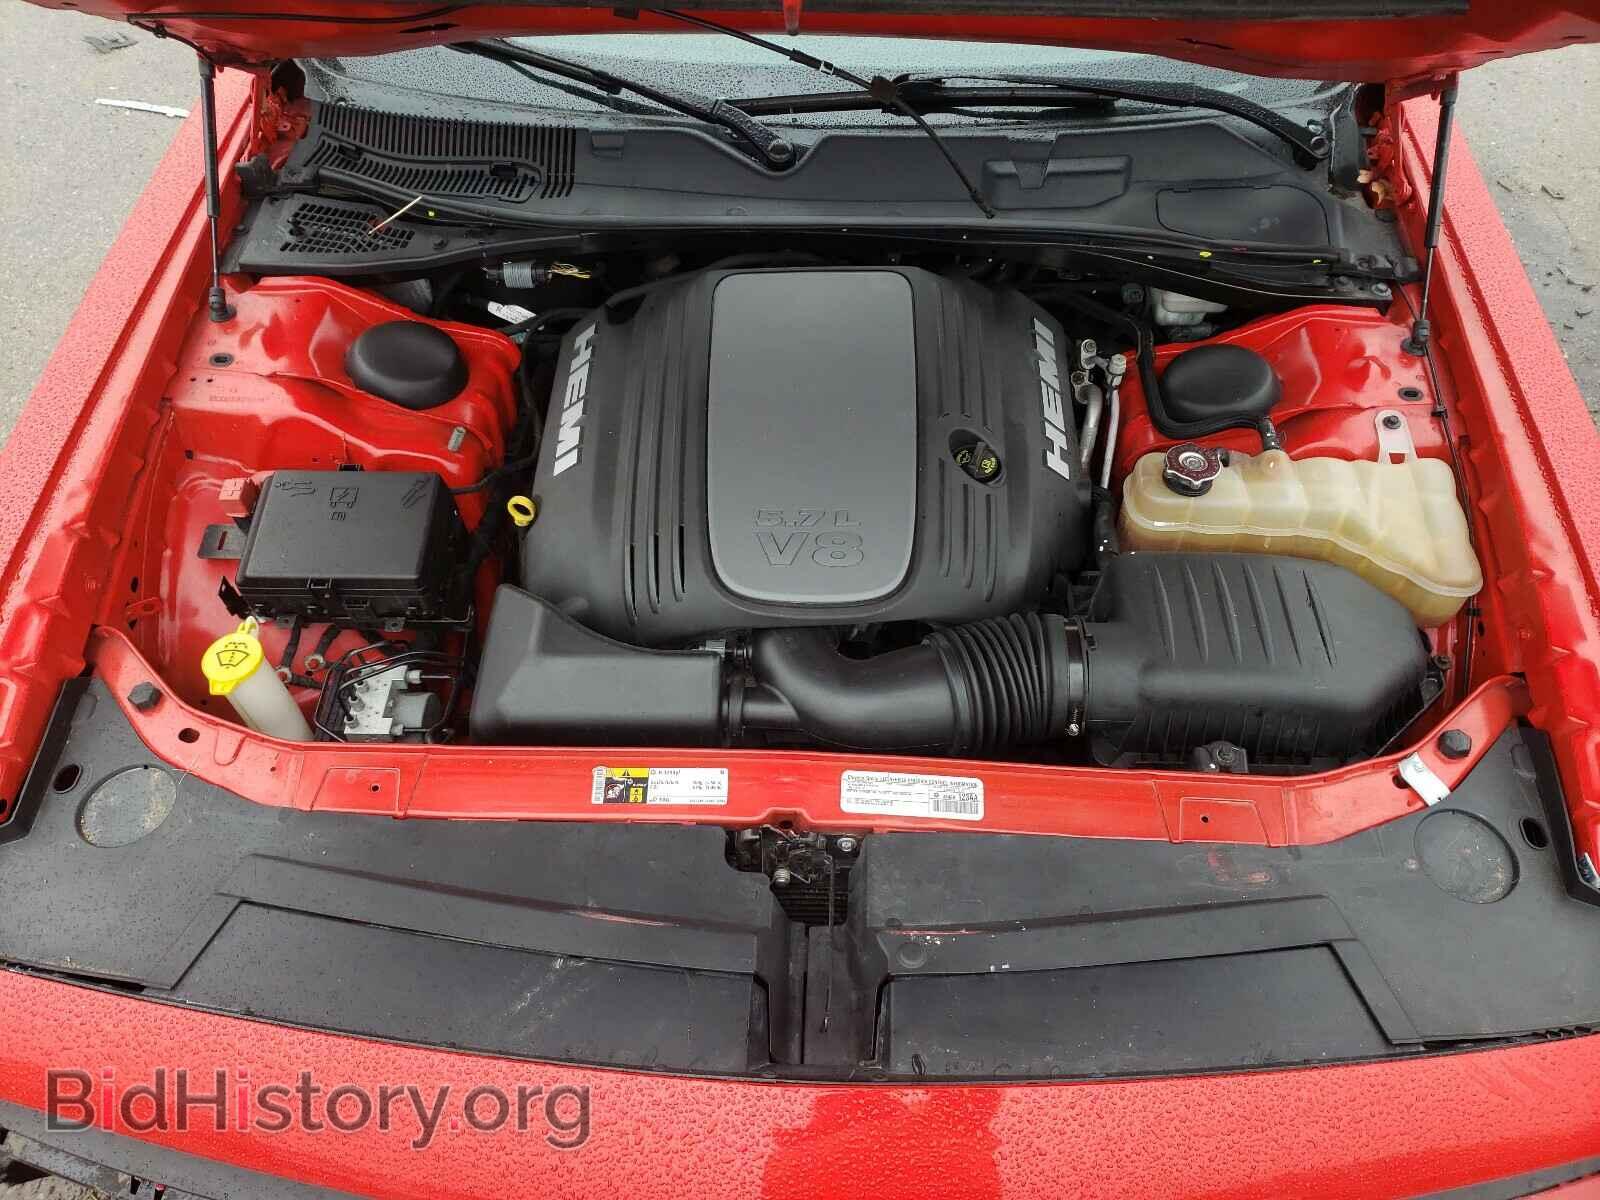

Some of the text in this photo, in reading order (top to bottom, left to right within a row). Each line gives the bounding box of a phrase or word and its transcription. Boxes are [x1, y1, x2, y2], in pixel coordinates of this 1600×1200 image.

[553, 323, 596, 477] HEMI
[1033, 317, 1070, 480] HEMI
[755, 508, 862, 527] 5.7L
[755, 531, 864, 568] V8
